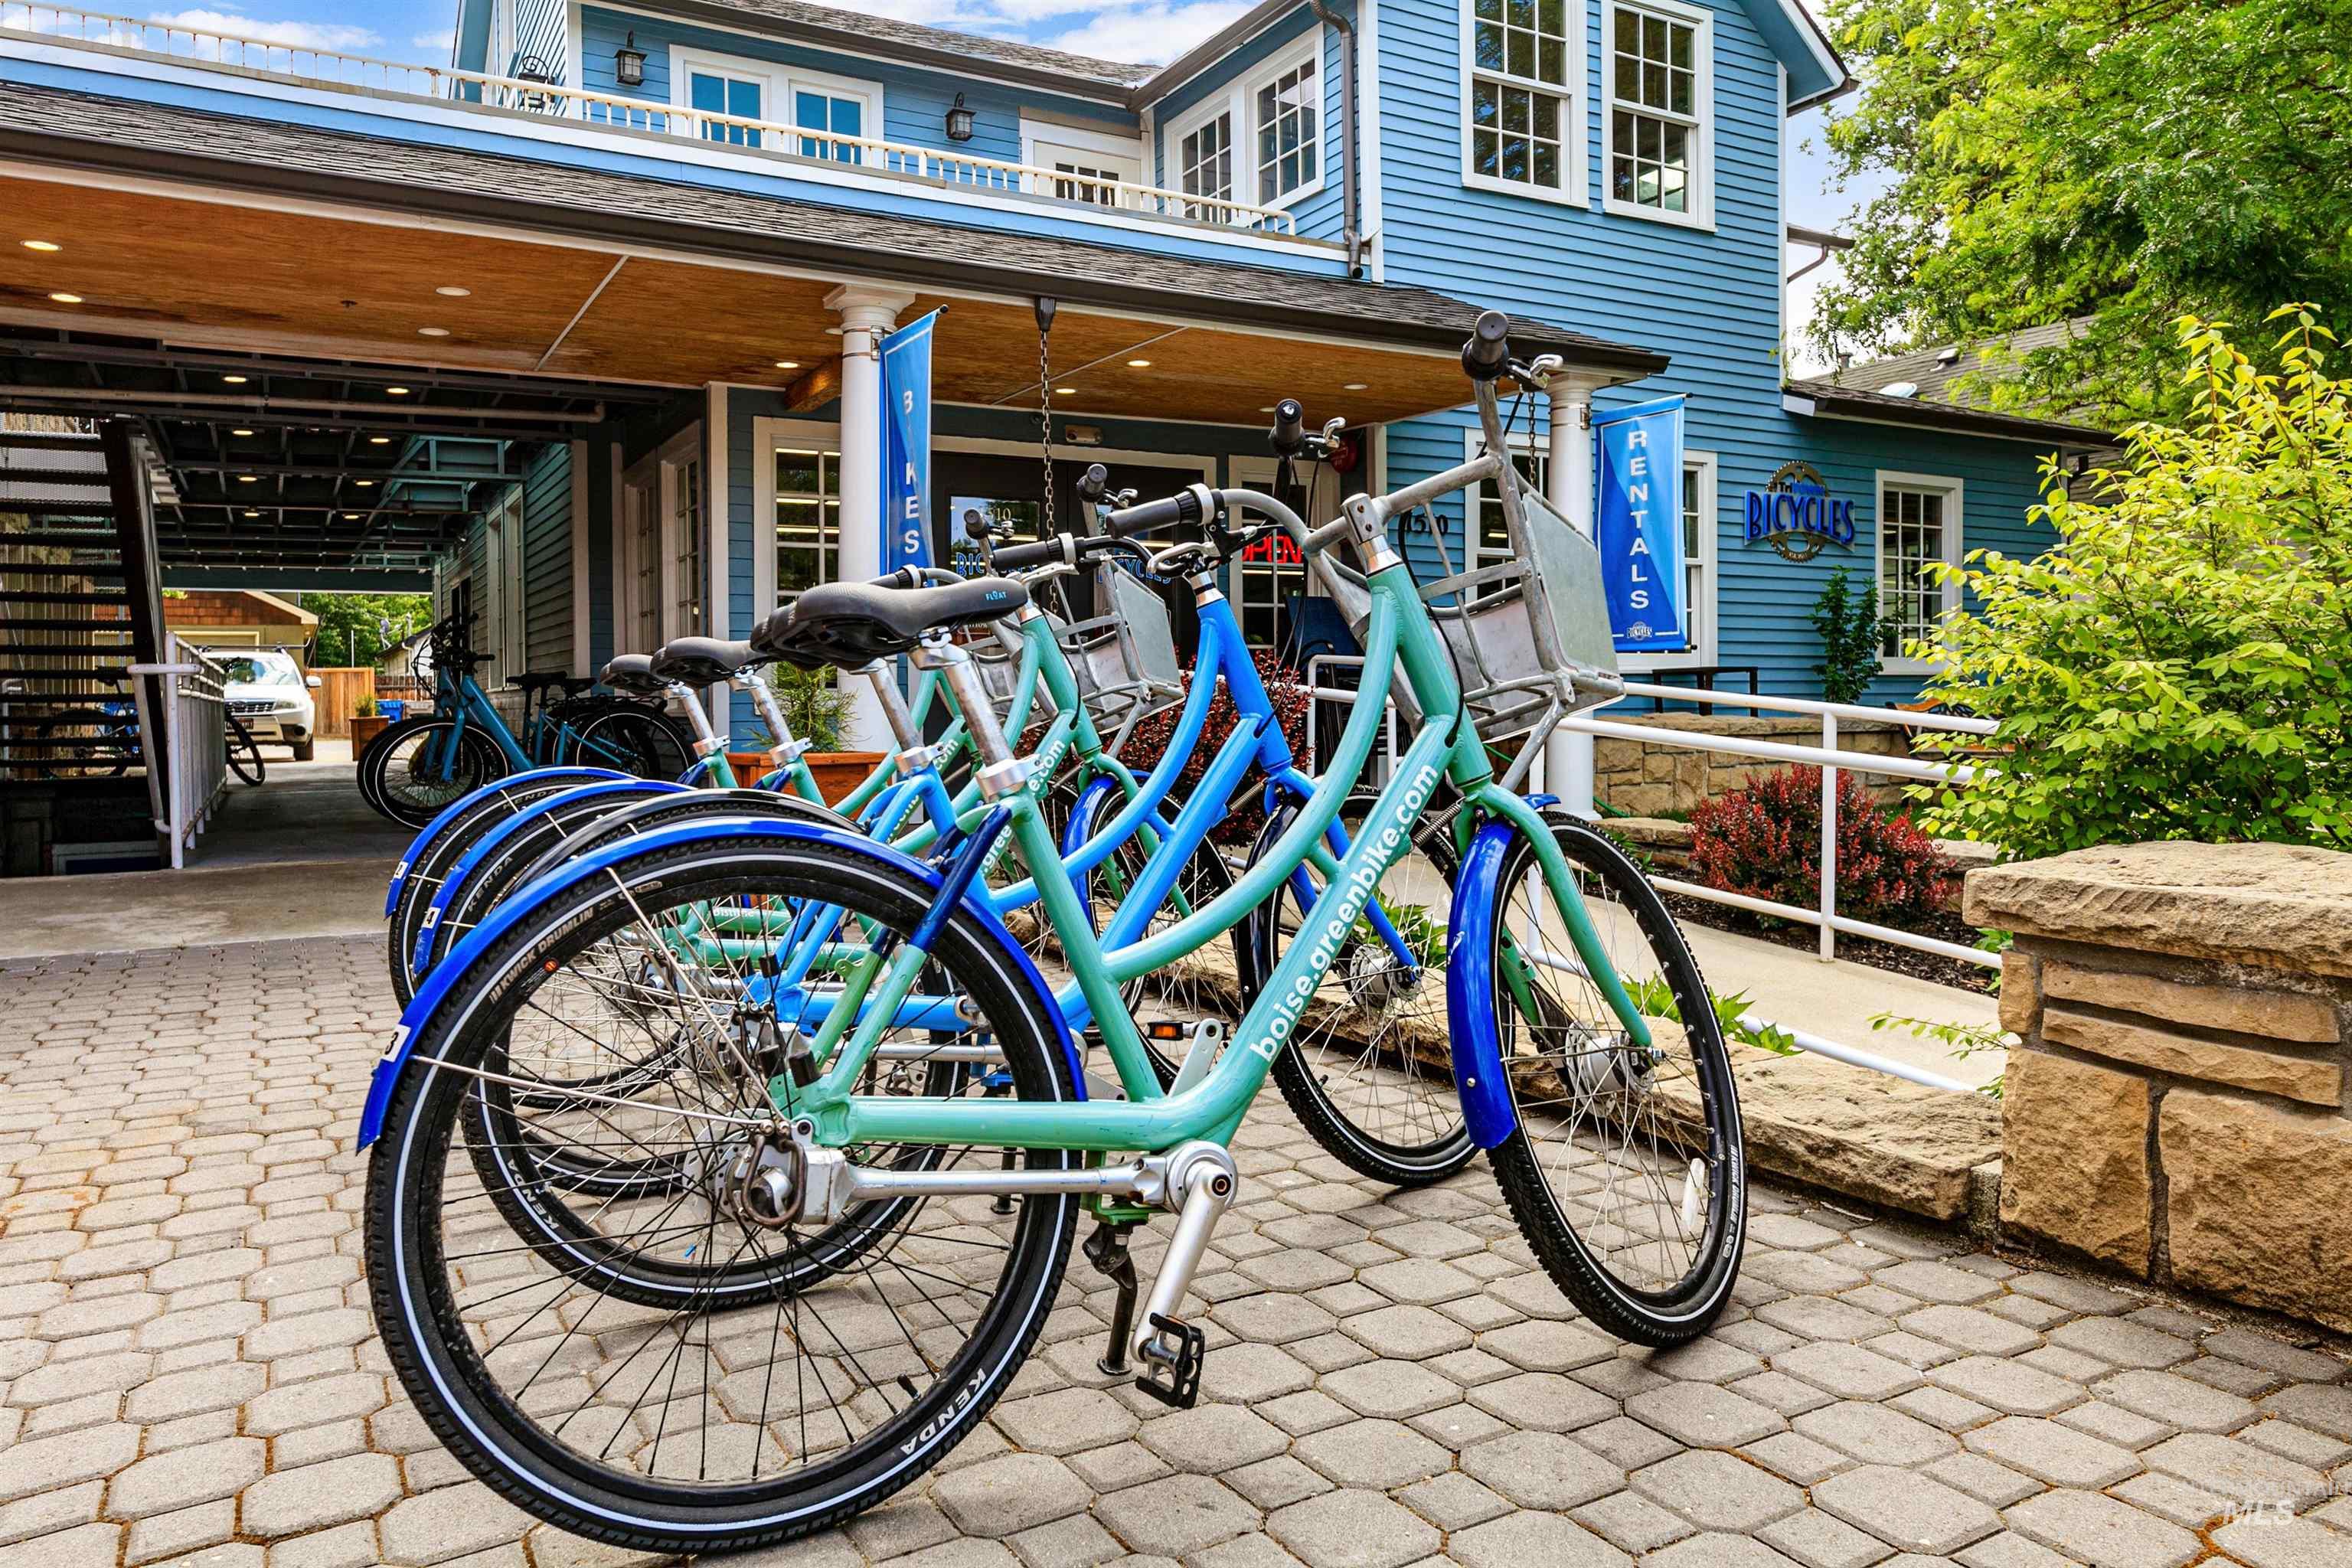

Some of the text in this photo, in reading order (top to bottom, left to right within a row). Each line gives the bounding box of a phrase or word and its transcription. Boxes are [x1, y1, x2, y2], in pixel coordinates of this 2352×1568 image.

[903, 390, 920, 555] BKES
[1628, 429, 1650, 610] RENTALS
[1746, 490, 1856, 546] BICYCLES
[985, 590, 1007, 601] FLOAT
[426, 910, 436, 925] 4
[467, 856, 514, 913] KENDA
[1249, 764, 1439, 1062] boise.greenbike.com
[501, 947, 537, 991] KWICK
[537, 906, 595, 953] DRUMLIN
[508, 1158, 560, 1230] KENDA
[900, 1367, 987, 1455] KENDA
